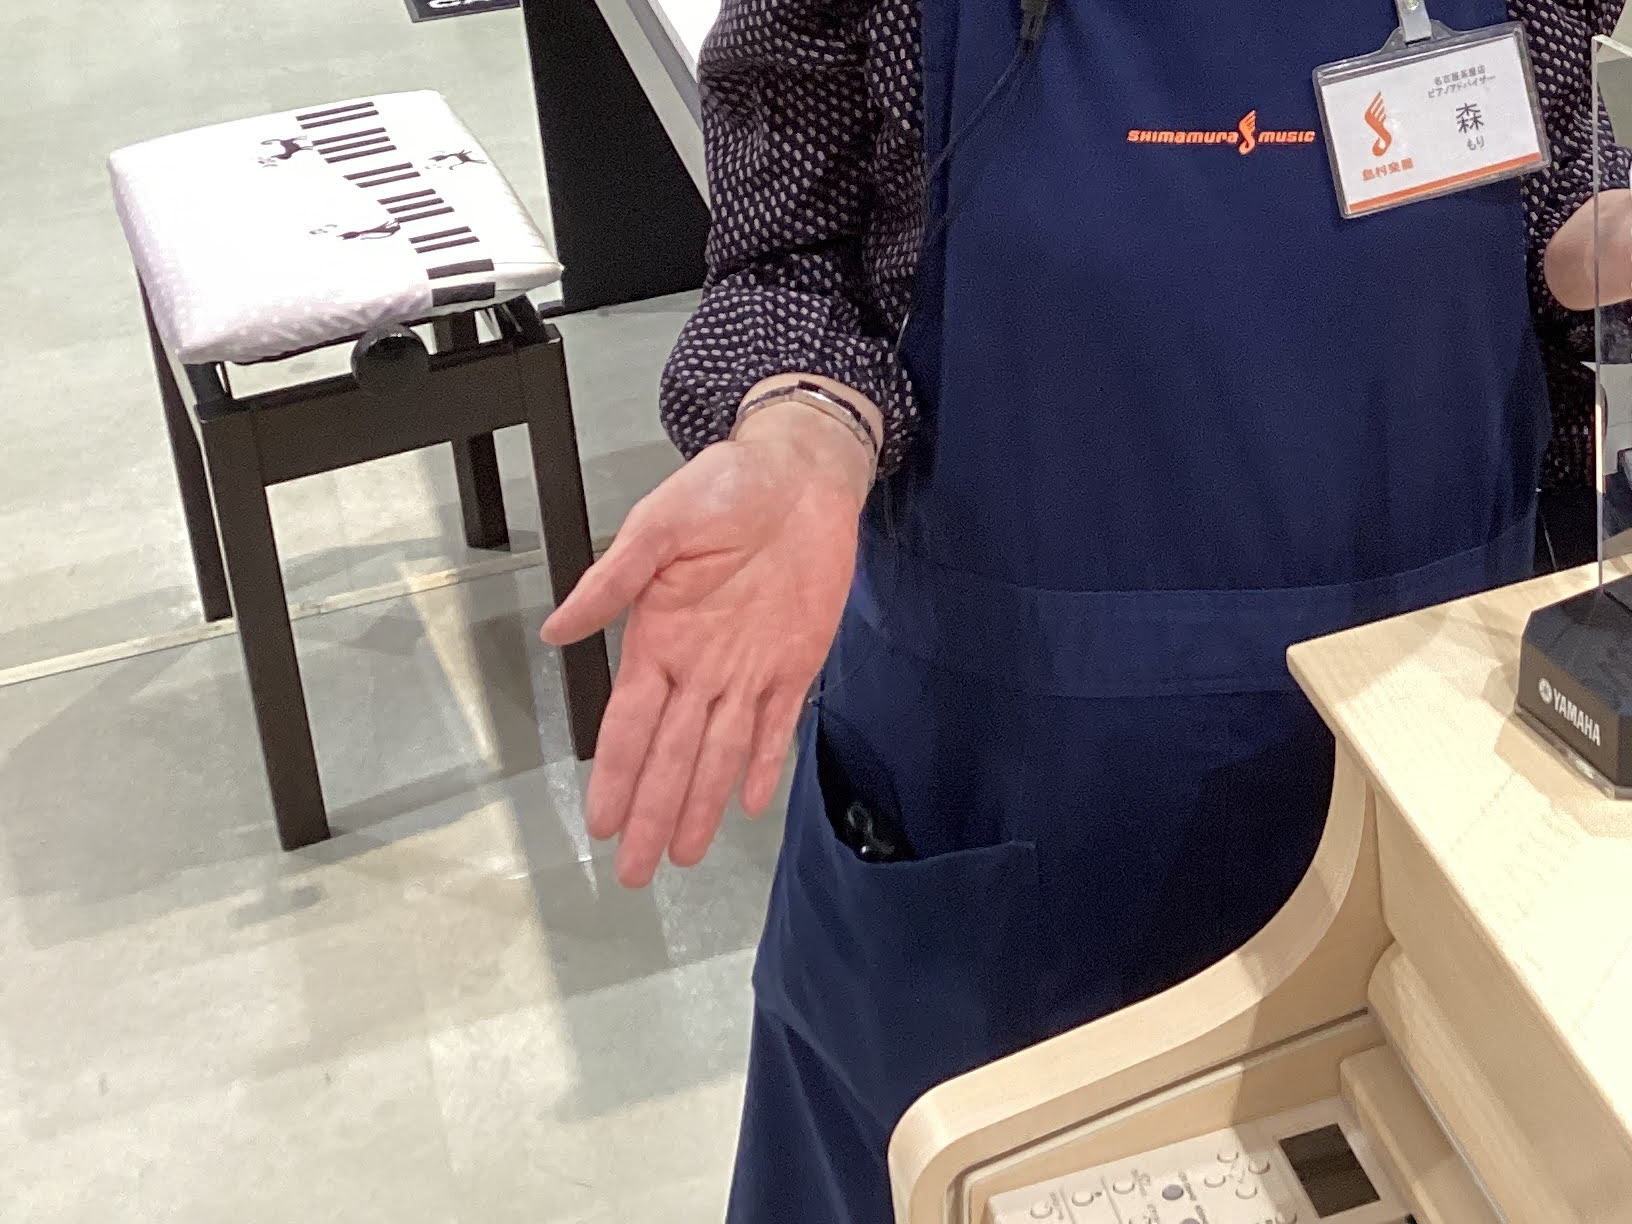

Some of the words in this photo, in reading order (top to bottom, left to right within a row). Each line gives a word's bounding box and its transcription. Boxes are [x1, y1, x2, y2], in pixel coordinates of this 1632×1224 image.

[1428, 75, 1497, 99] ピアノアドバイザー
[1455, 102, 1485, 134] 森
[1466, 135, 1485, 151] もり
[1551, 685, 1601, 746] YAMAHA
